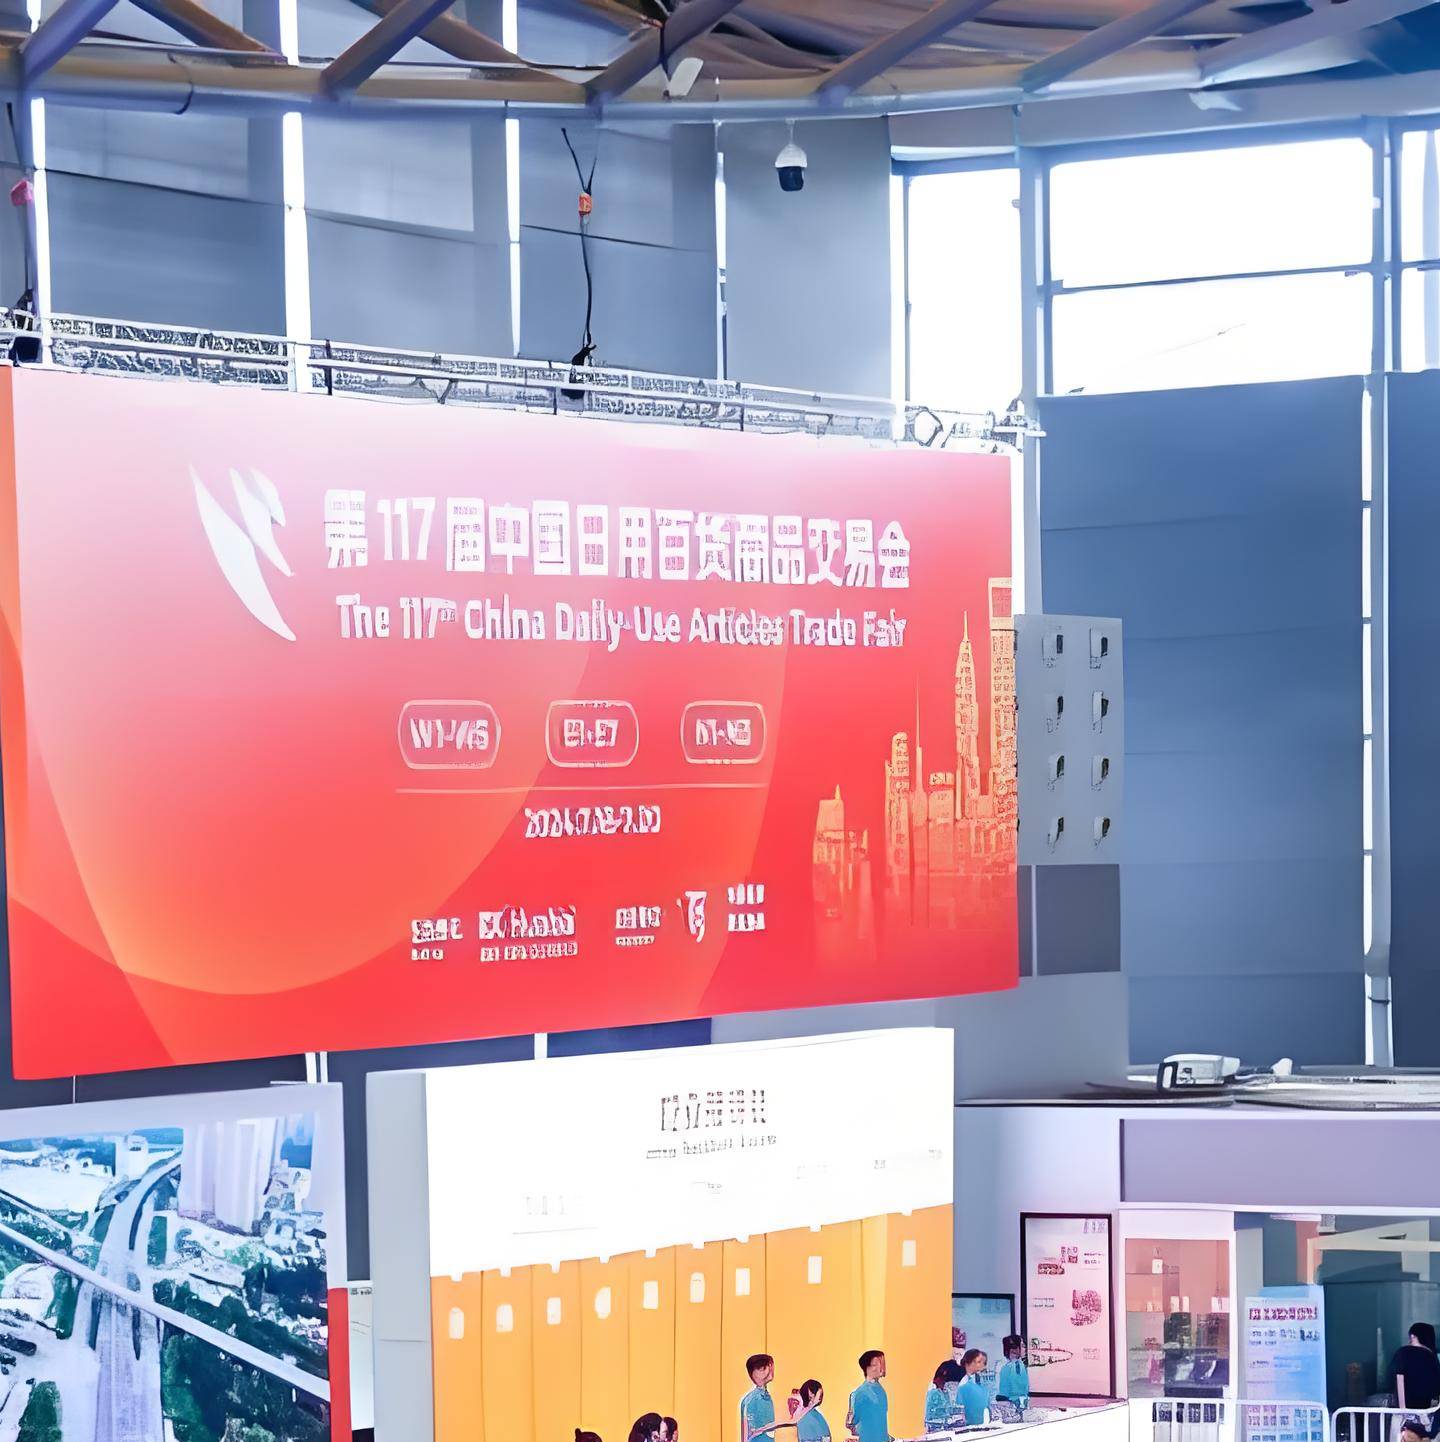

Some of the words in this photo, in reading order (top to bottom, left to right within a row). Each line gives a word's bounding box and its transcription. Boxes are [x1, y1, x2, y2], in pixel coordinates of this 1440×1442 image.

[336, 593, 390, 638] The
[464, 593, 546, 640] China
[688, 607, 784, 646] Articles
[789, 608, 856, 646] Trade
[863, 608, 907, 647] Fair
